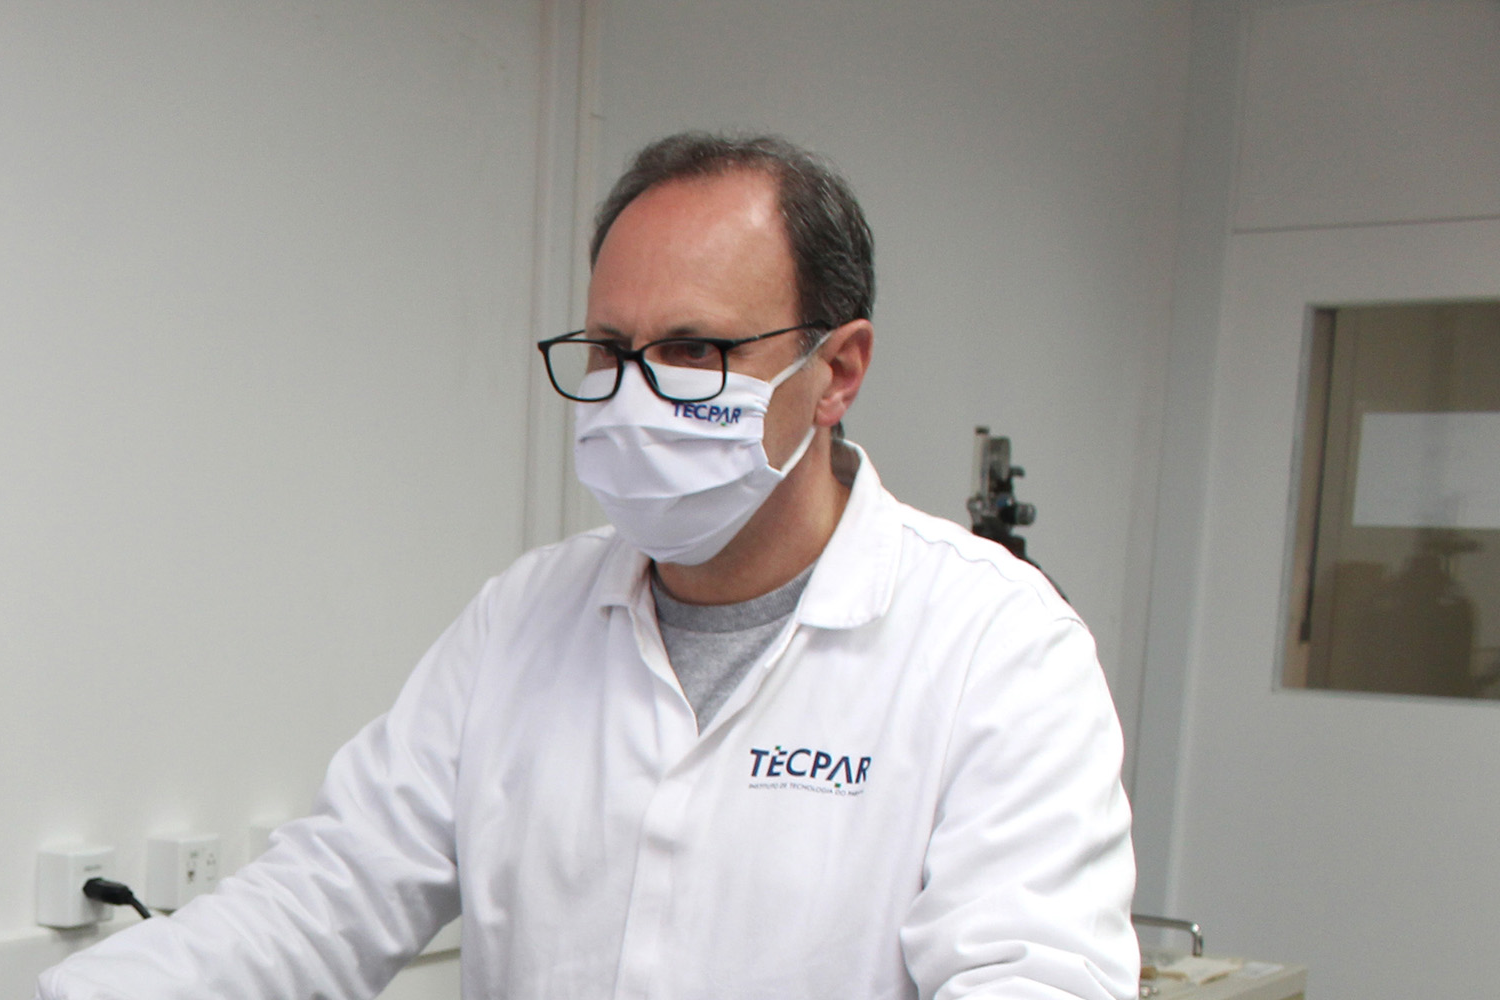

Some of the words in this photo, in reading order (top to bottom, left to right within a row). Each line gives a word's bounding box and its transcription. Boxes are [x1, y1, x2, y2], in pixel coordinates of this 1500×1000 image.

[673, 402, 742, 424] TECPAR
[750, 746, 872, 787] TECPAR
[789, 782, 833, 794] TECNOLOGIA
